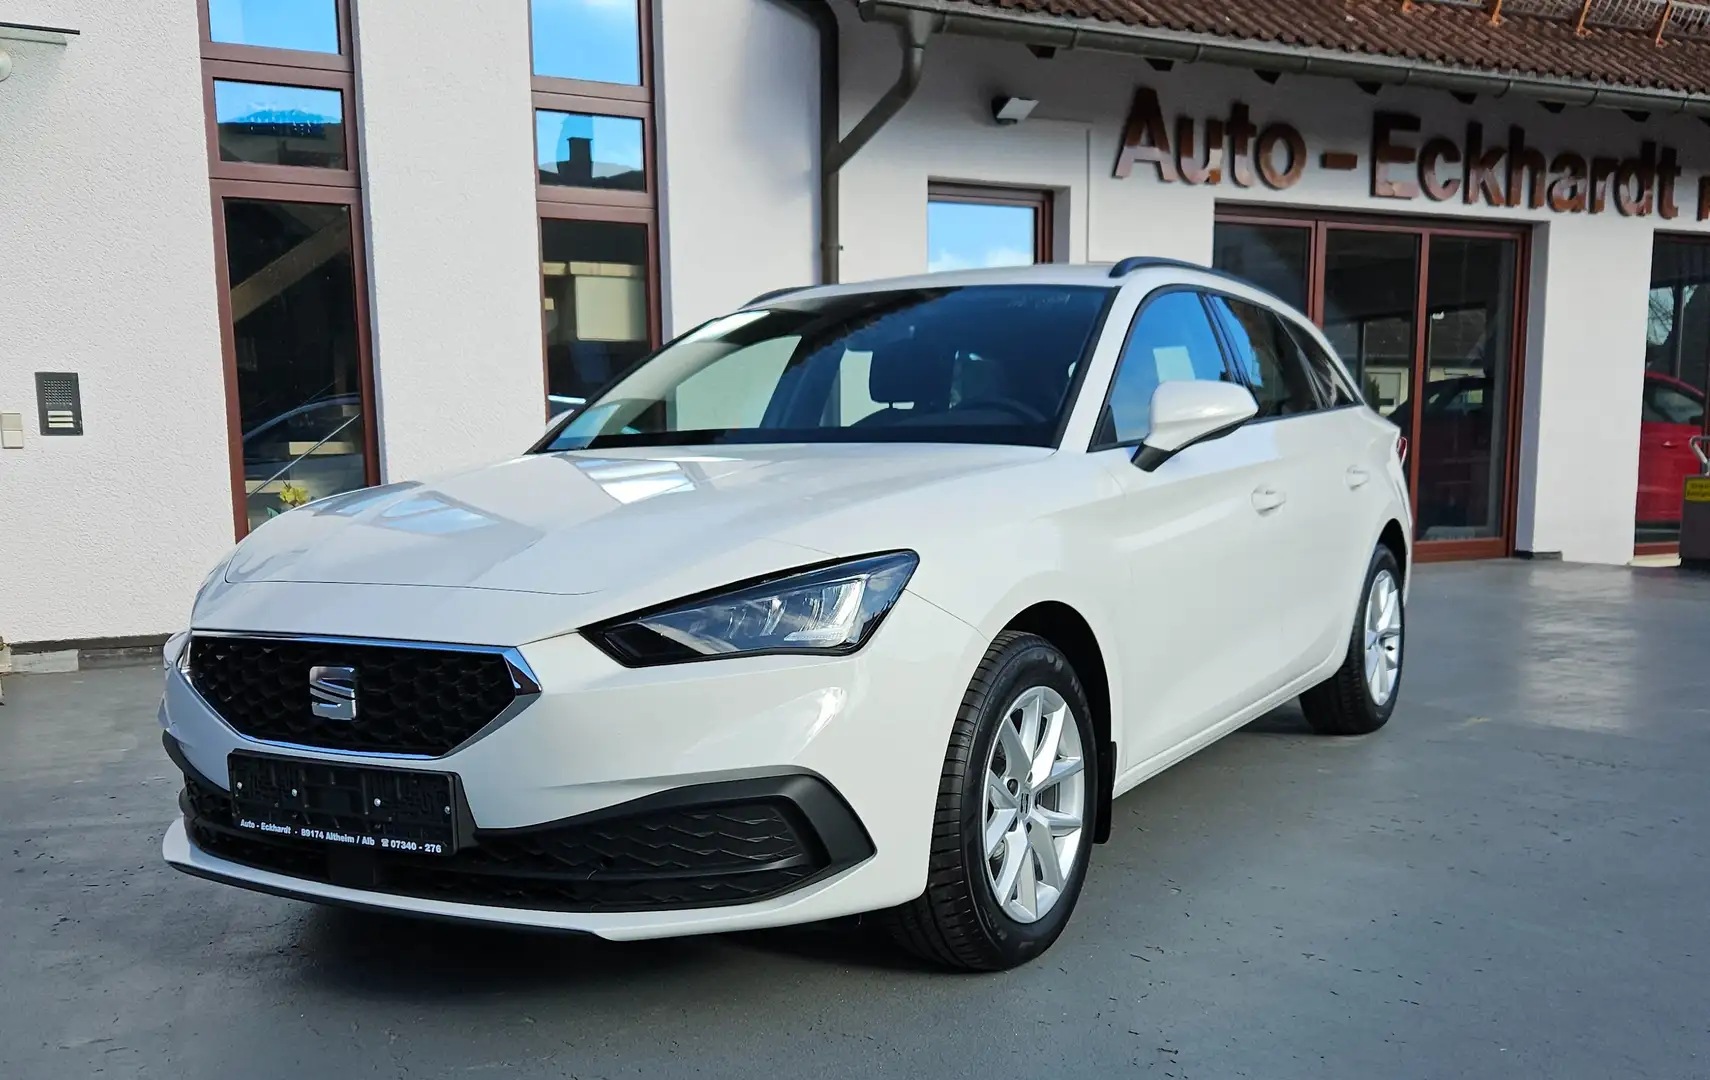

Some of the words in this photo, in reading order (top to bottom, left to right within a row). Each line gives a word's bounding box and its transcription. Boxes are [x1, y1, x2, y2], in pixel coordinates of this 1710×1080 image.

[1112, 86, 1307, 191] Auto
[1369, 109, 1682, 221] Eckhardt
[240, 818, 256, 829] Auto
[260, 821, 293, 835] Eckhardt
[300, 828, 325, 840] 89174
[325, 831, 356, 844] Altheim
[361, 835, 376, 846] Alb
[390, 839, 418, 851] 07340
[424, 843, 443, 854] 276
